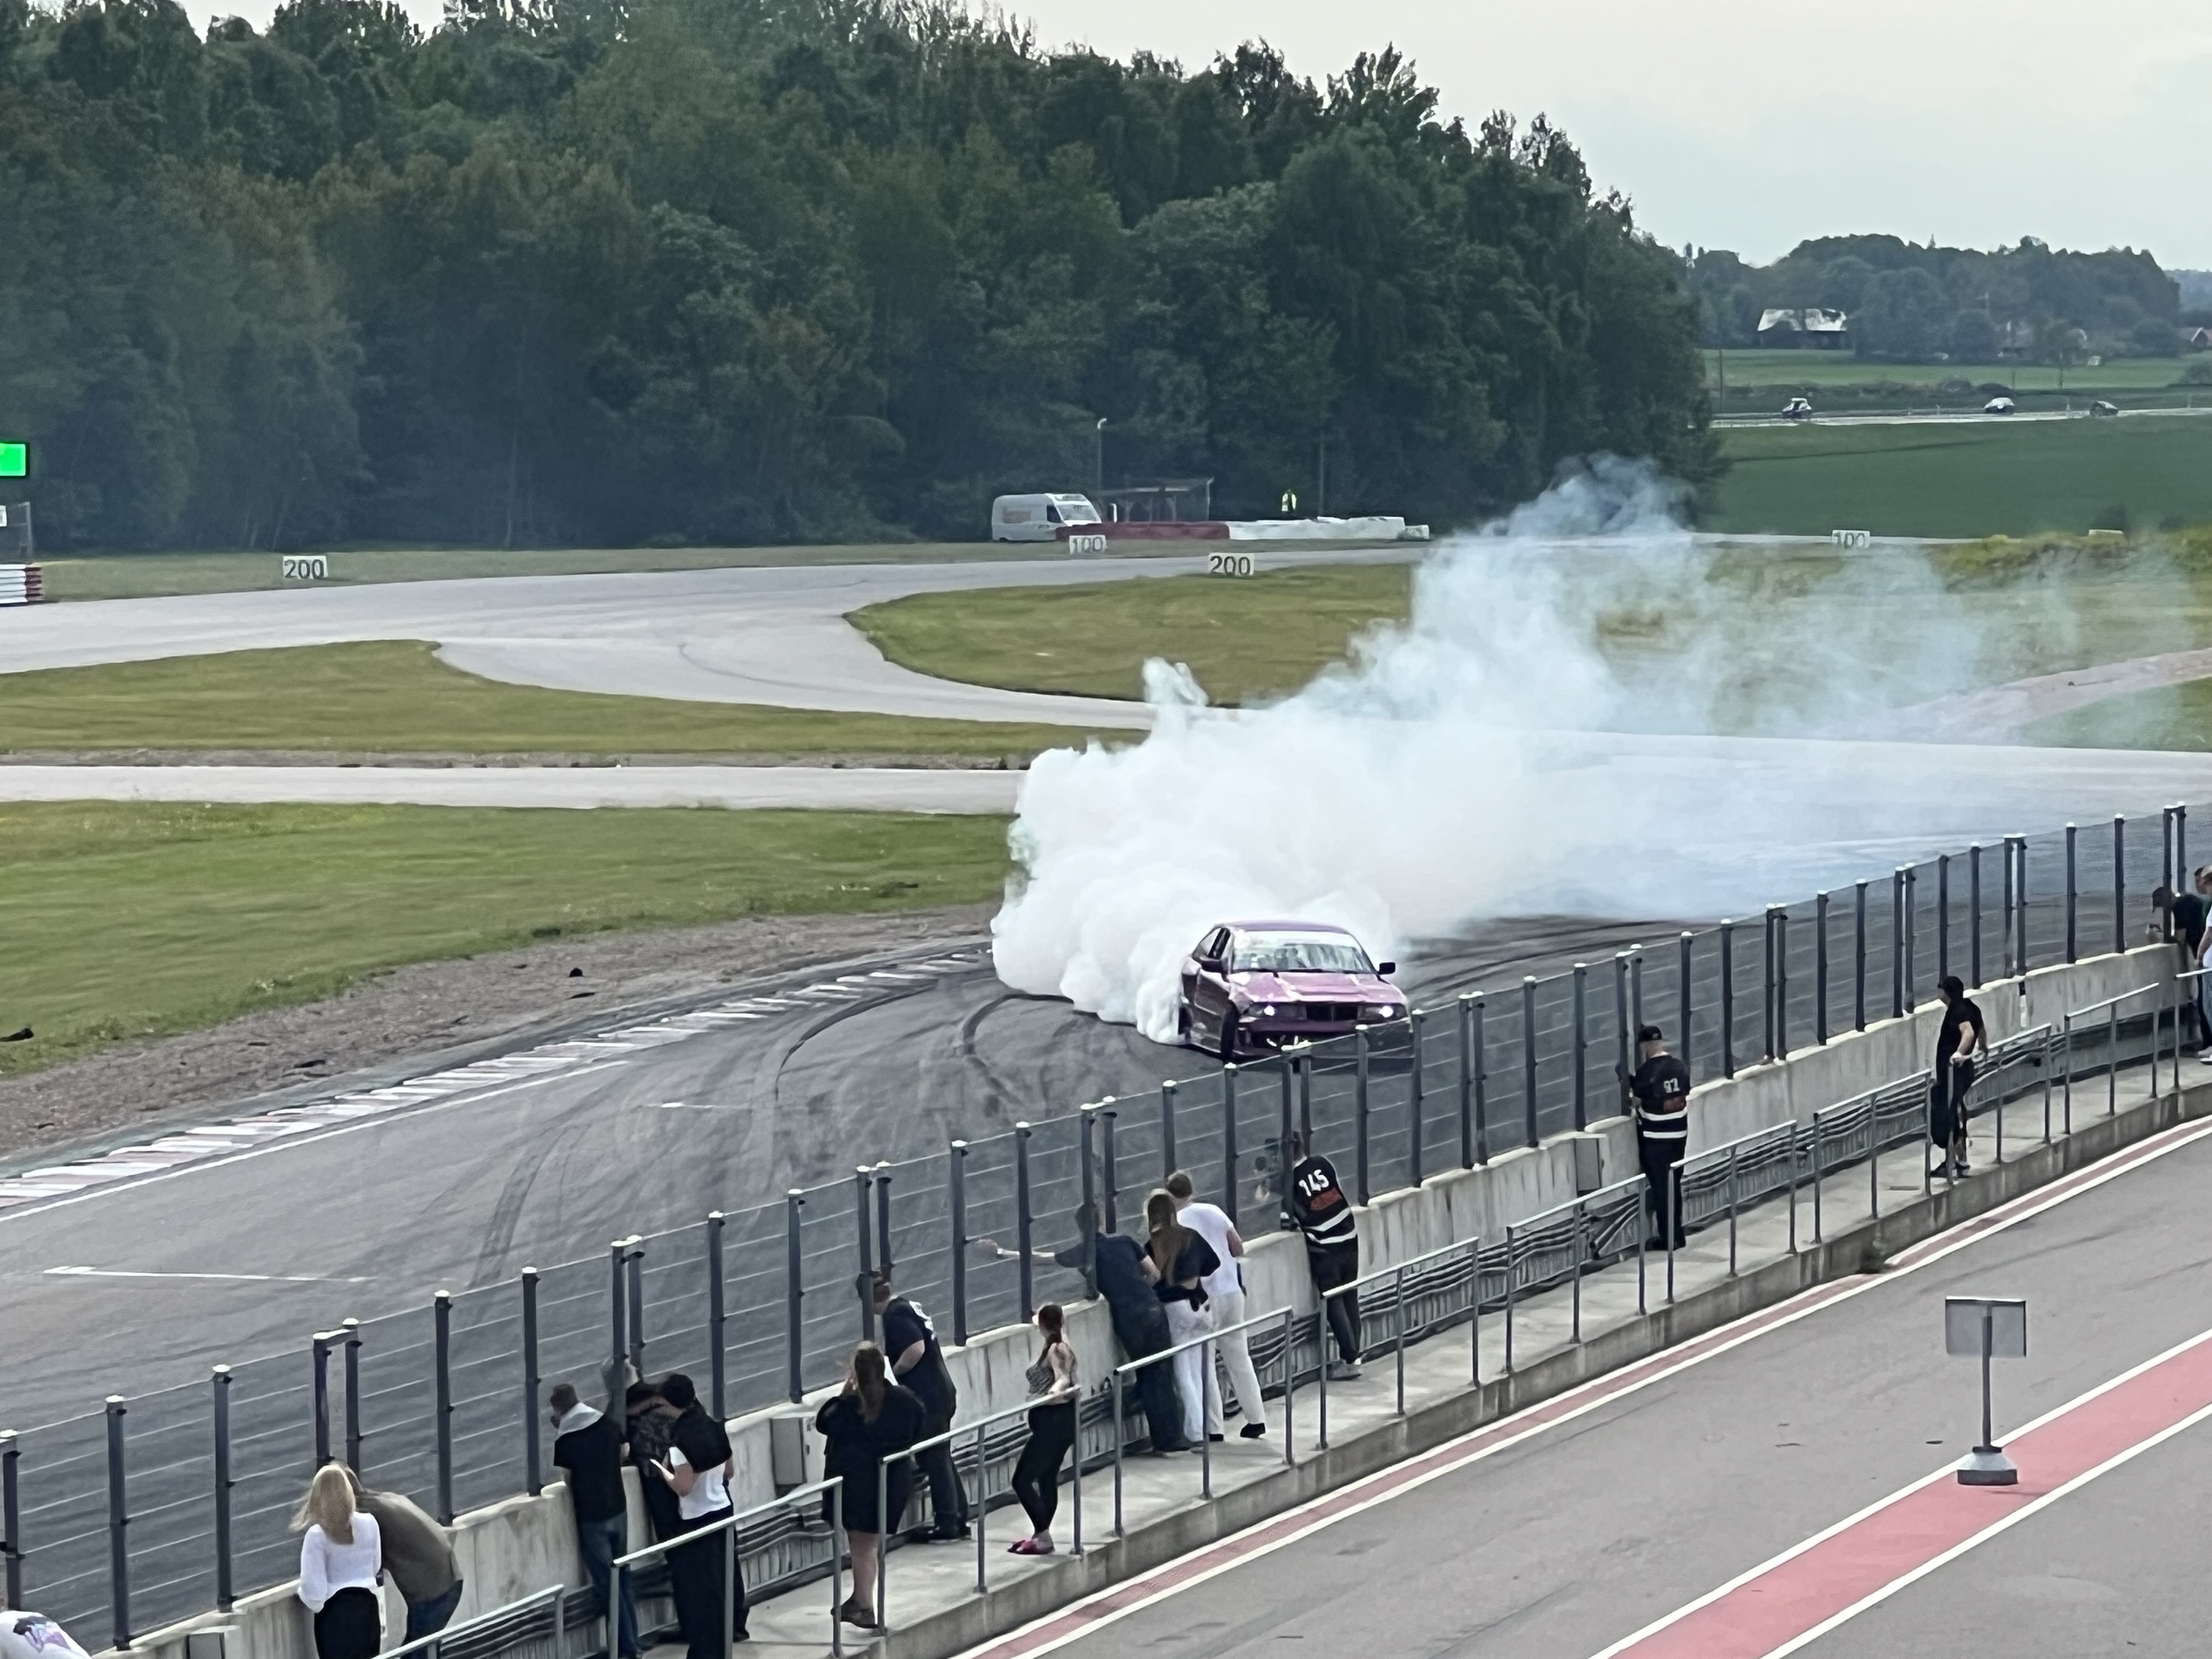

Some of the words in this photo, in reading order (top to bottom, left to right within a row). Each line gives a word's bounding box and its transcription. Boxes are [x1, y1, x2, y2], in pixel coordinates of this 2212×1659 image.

[1073, 537, 1103, 553] 100
[1833, 532, 1865, 549] 100
[284, 559, 324, 579] 200
[1210, 556, 1250, 575] 200
